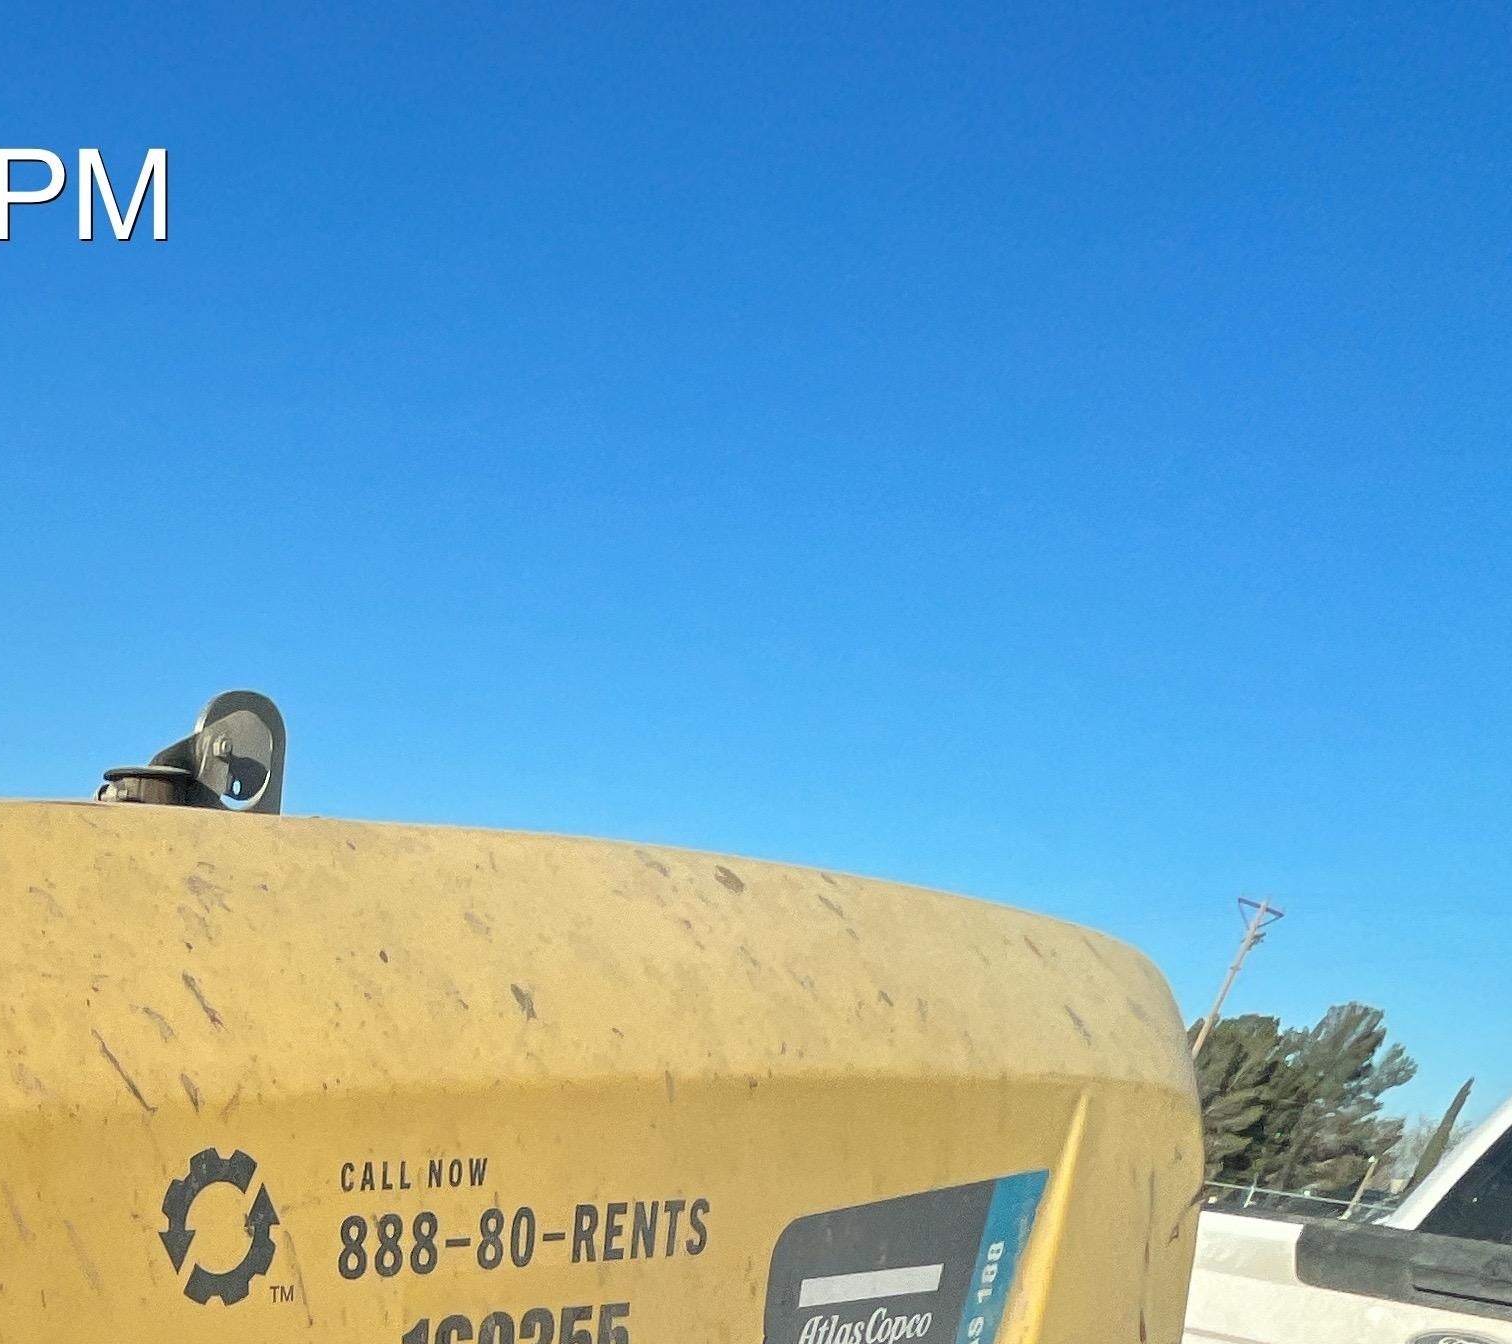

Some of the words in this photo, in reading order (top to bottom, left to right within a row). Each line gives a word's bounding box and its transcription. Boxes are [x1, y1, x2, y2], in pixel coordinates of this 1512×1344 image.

[340, 1160, 411, 1192] CALL
[427, 1157, 488, 1189] NOW
[338, 1198, 710, 1280] 888-80-RENTS
[269, 1284, 294, 1304] TM
